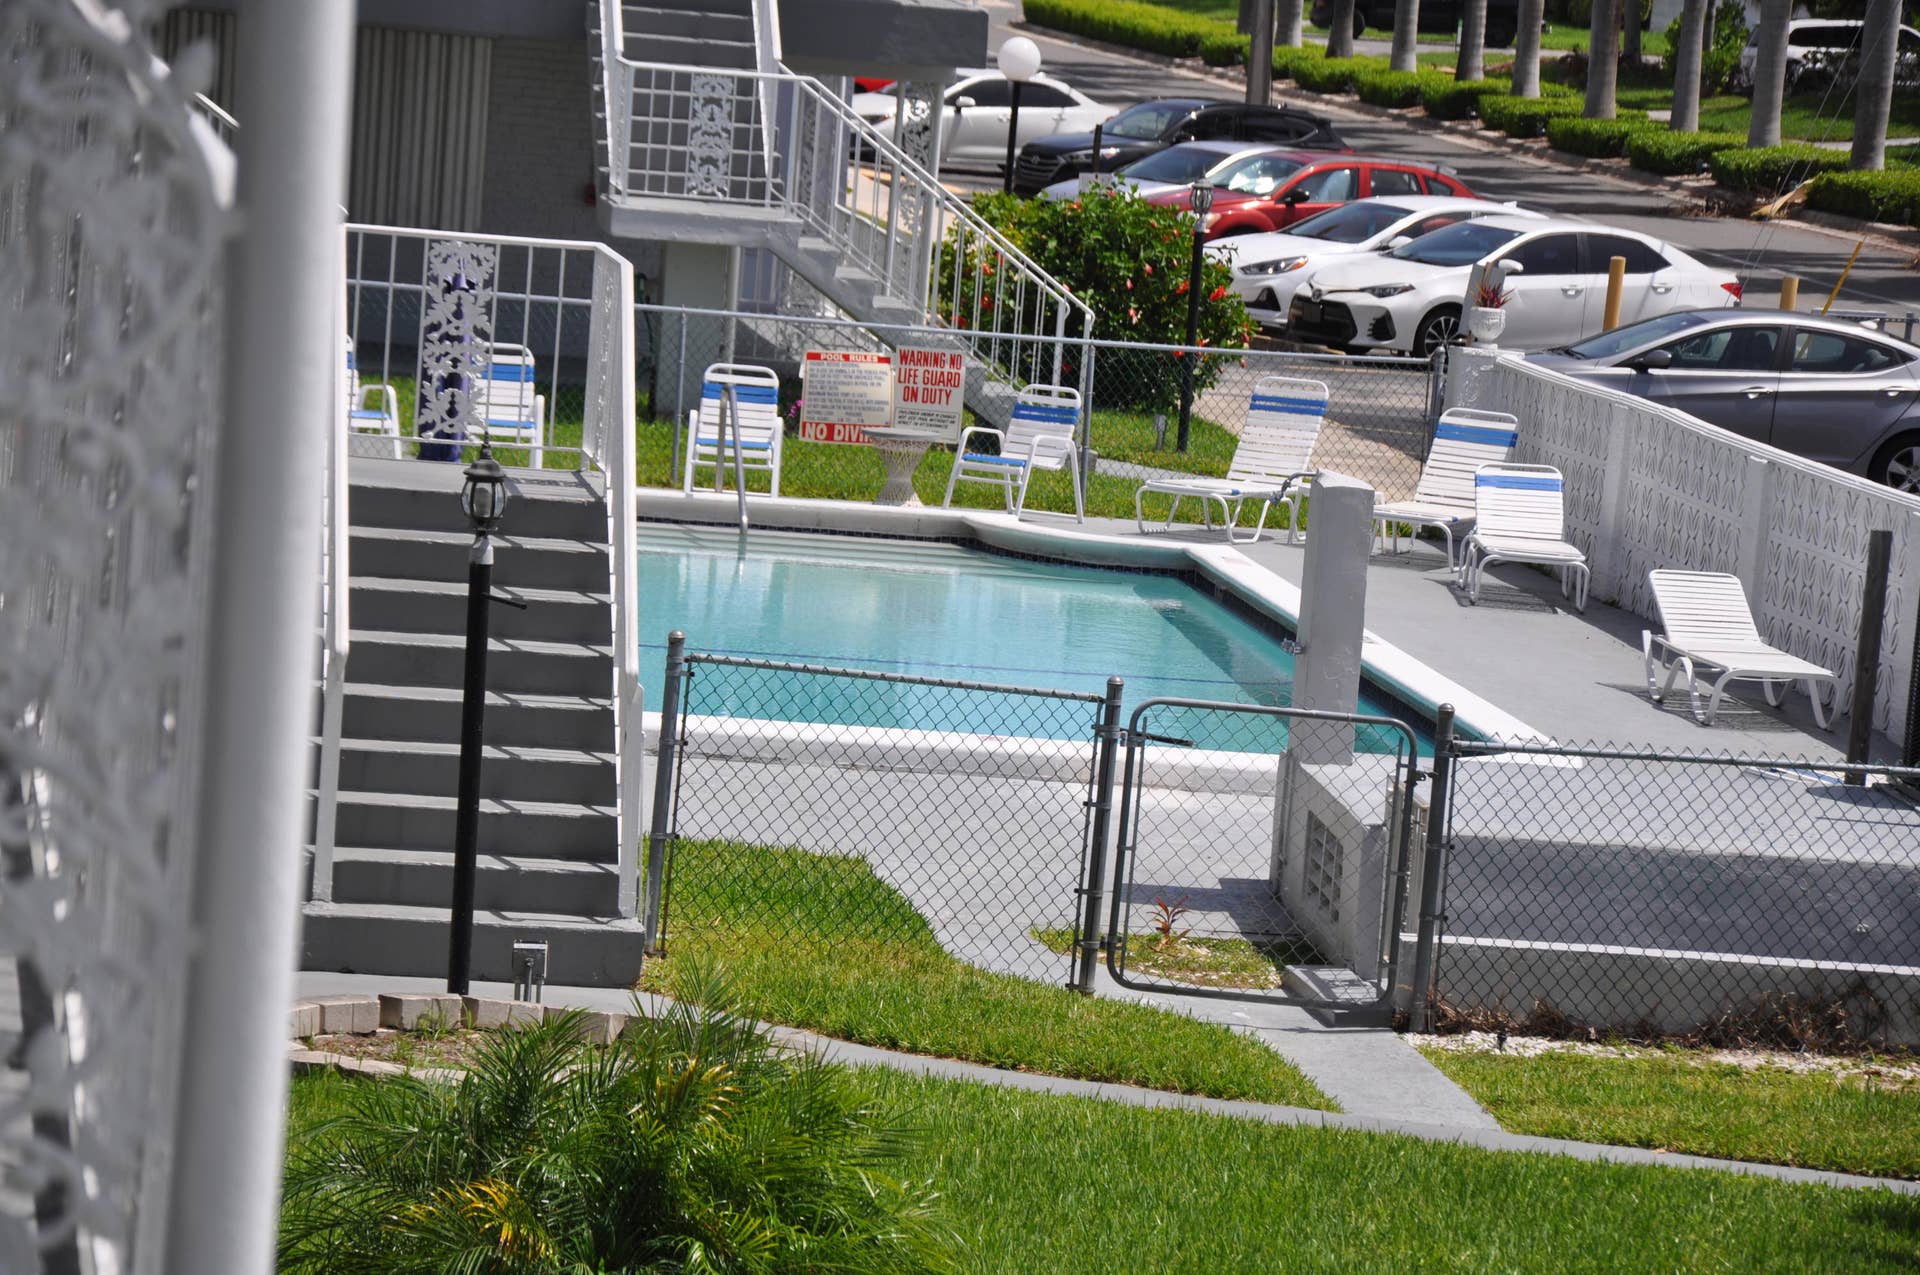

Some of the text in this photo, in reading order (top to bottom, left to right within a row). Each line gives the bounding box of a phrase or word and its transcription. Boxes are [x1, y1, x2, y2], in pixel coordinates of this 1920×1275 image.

[820, 352, 879, 363] POOL RULES
[899, 349, 962, 370] WARNING NO
[898, 367, 919, 385] LIFE
[922, 369, 961, 388] GUARD
[903, 385, 919, 403] ON
[921, 387, 952, 405] DUTY
[804, 422, 828, 441] NO
